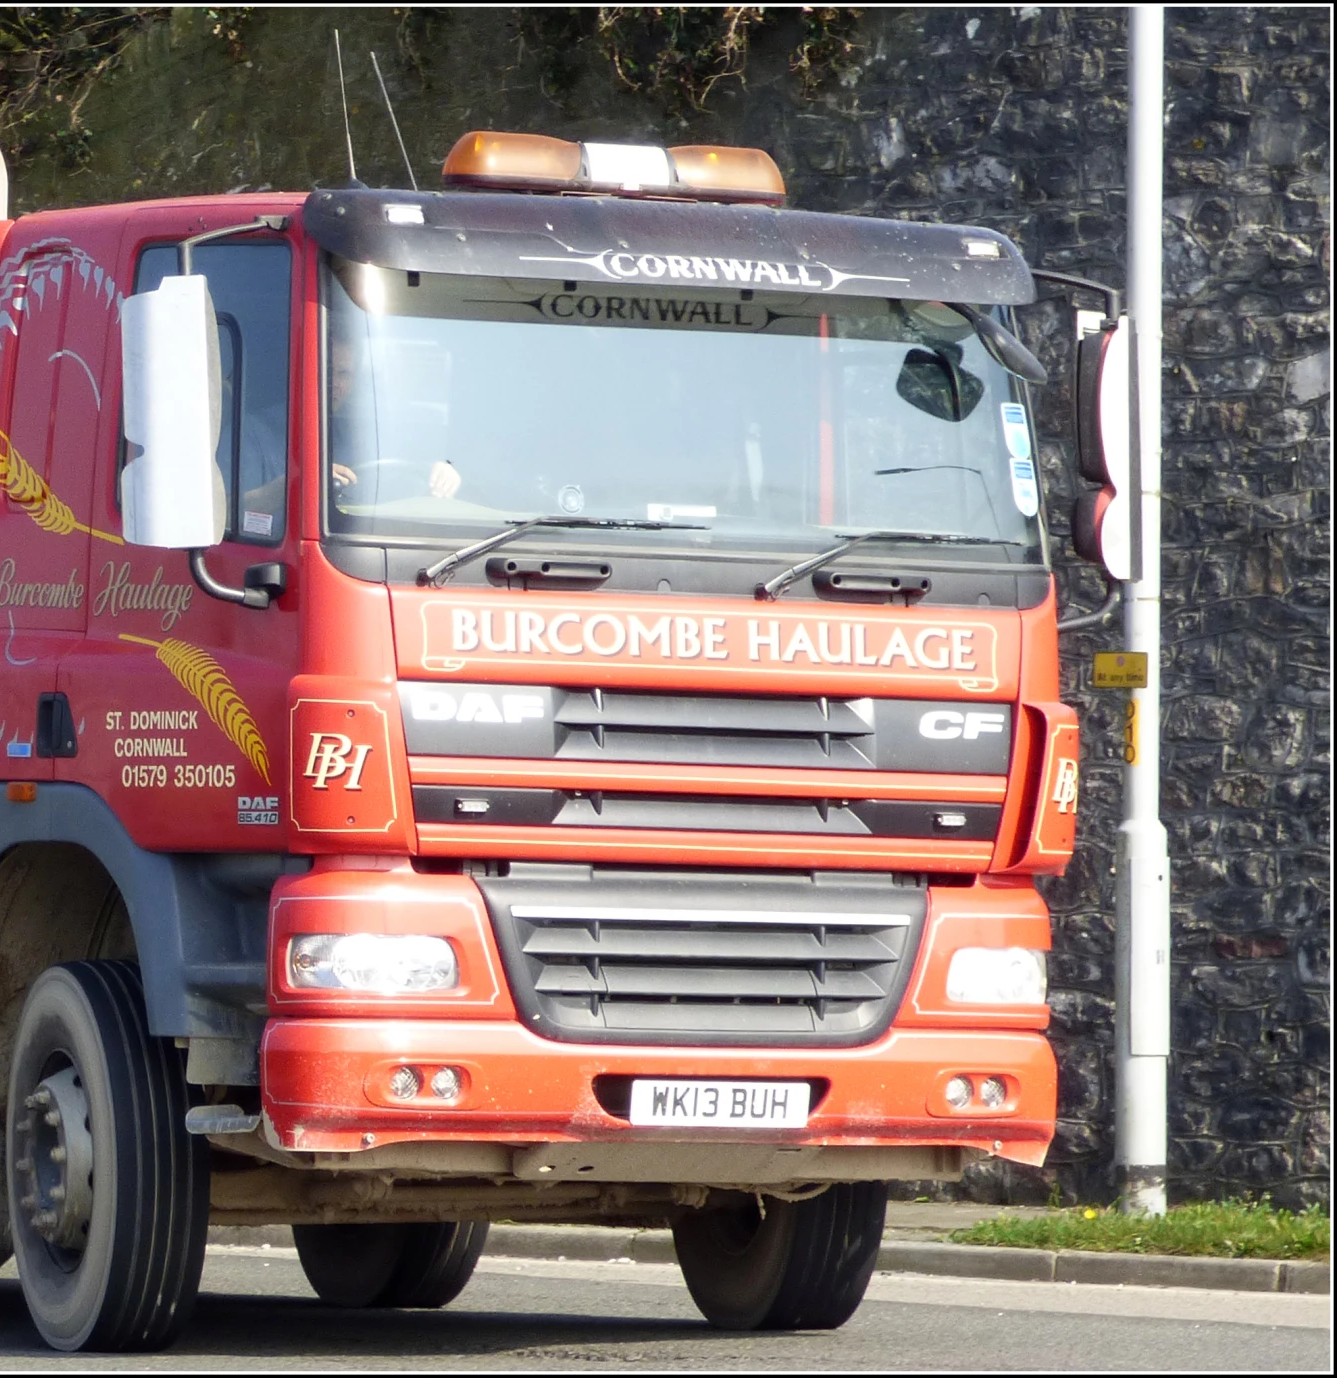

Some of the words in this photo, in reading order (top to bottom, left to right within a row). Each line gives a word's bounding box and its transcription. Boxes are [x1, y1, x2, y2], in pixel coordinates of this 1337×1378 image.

[610, 253, 822, 287] CORNWALL
[550, 294, 755, 327] CORNWALL
[93, 561, 194, 632] Haulage
[451, 609, 728, 661] BURCOMBE
[748, 619, 977, 672] HAULAGE
[105, 711, 125, 731] ST.
[130, 710, 199, 730] DOMINICK
[411, 690, 544, 725] DAF
[918, 710, 1005, 741] CF
[114, 738, 188, 758] CORNWALL
[122, 764, 168, 788] 01579
[173, 764, 236, 788] 350105
[237, 796, 279, 810] DAF
[238, 812, 278, 824] 85.410
[652, 1086, 720, 1118] WK13
[729, 1088, 789, 1119] BUH
